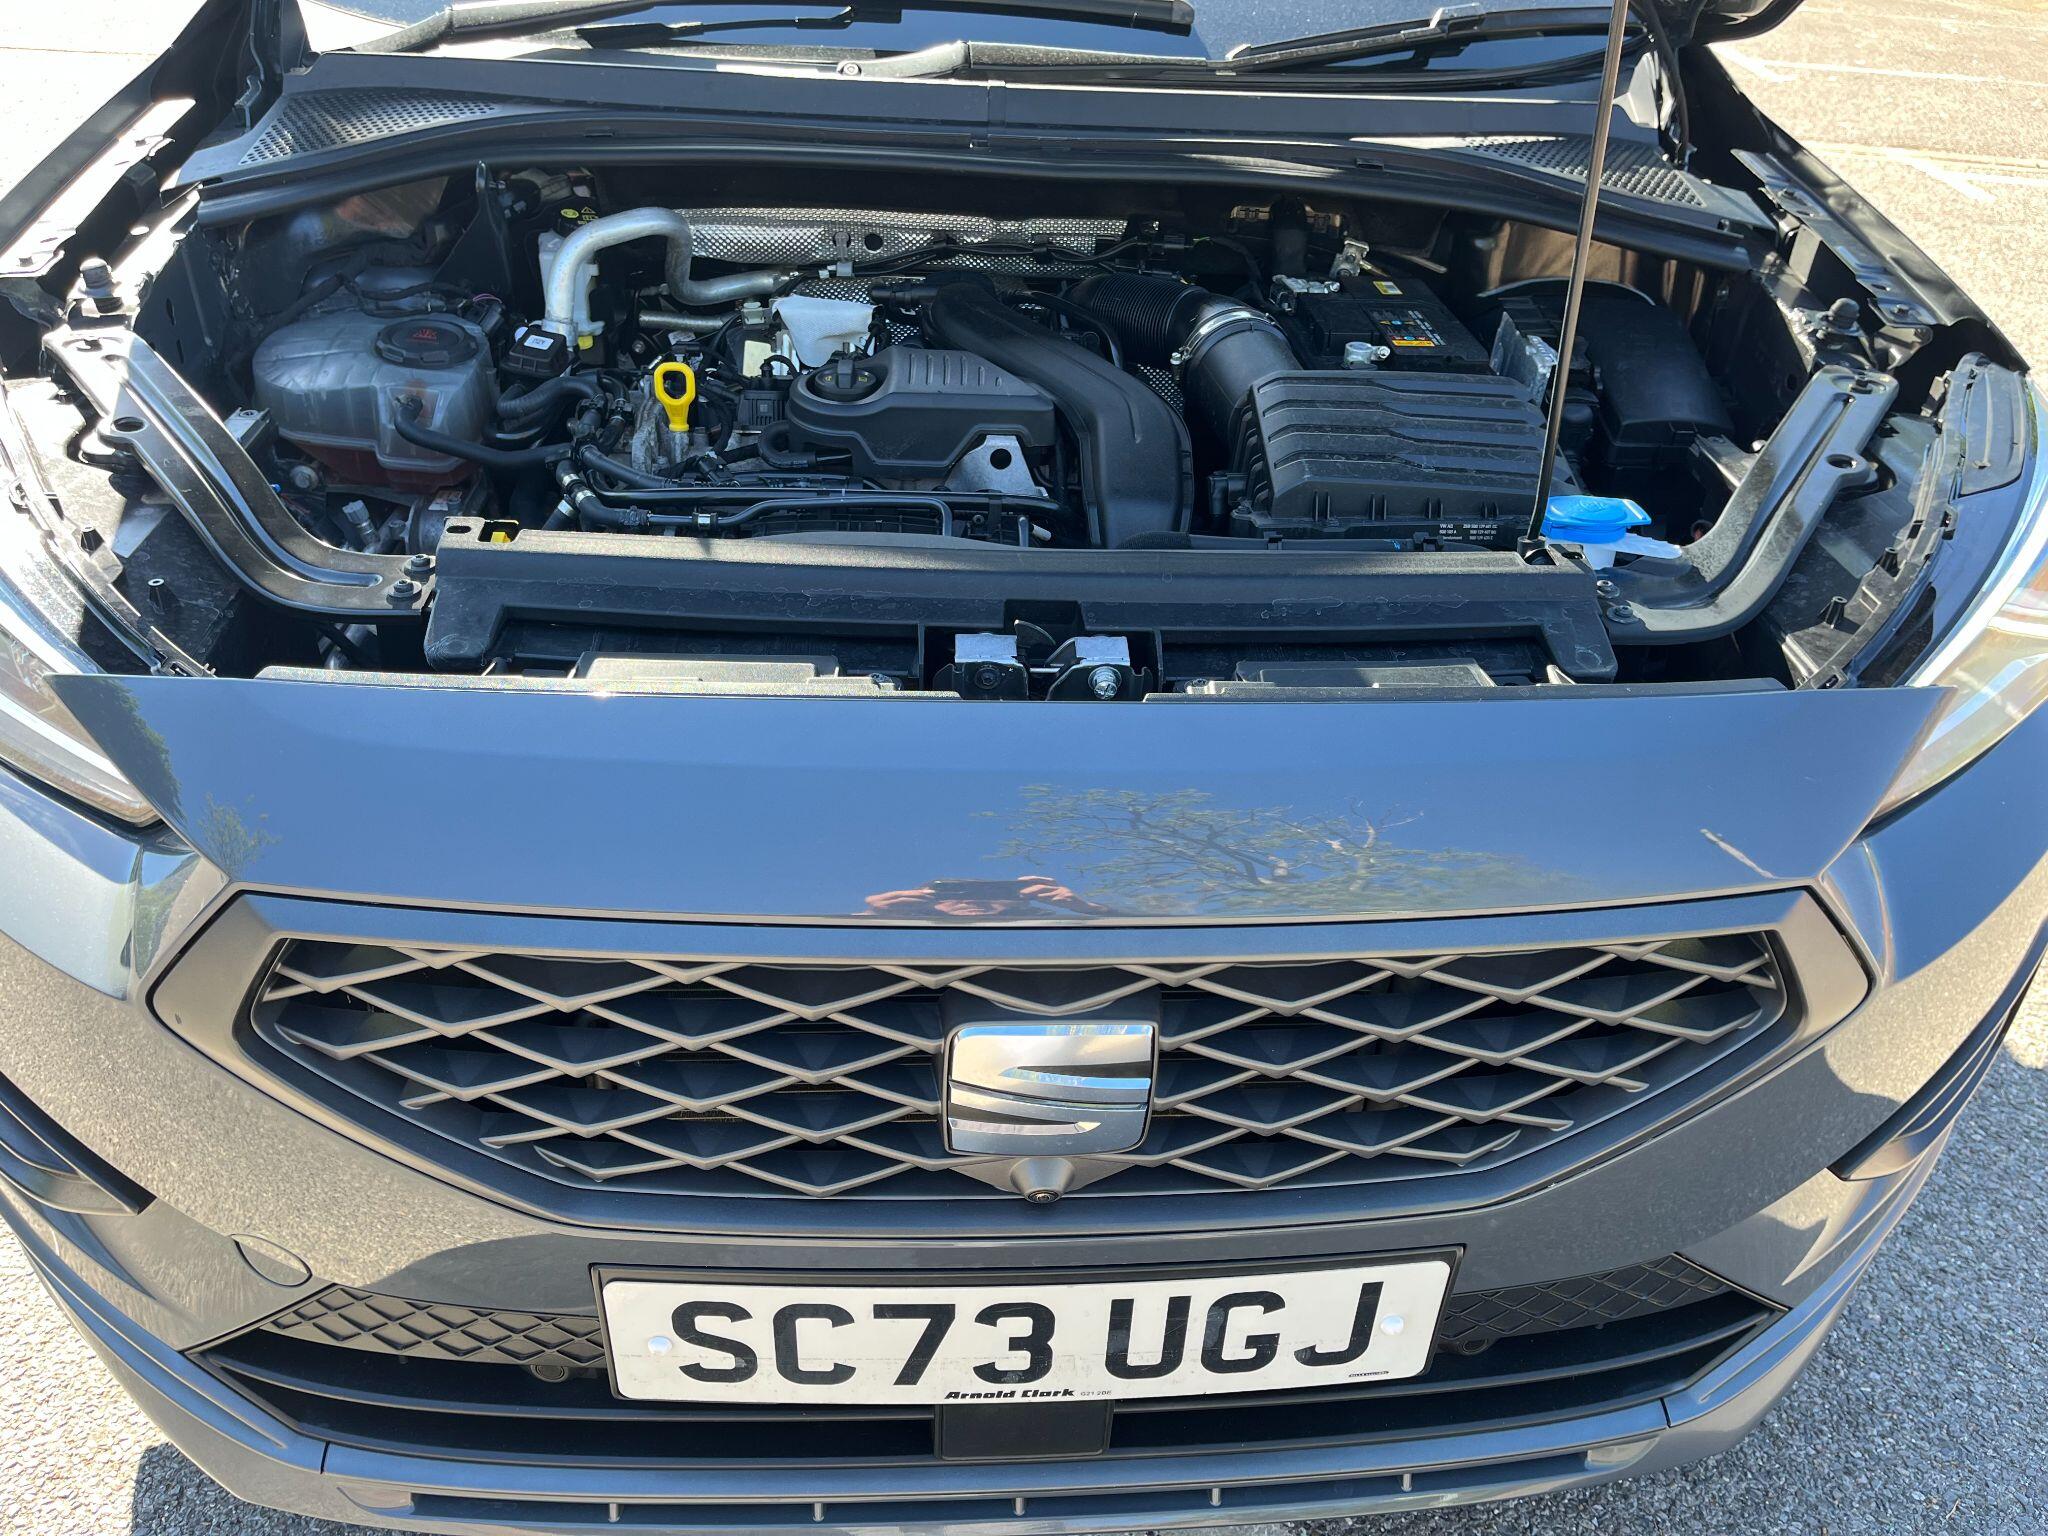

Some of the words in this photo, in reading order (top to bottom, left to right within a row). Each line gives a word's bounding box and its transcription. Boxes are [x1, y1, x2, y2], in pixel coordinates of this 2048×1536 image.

[671, 1300, 1056, 1386] SC73
[1104, 1281, 1384, 1380] UGJ
[944, 1390, 1015, 1400] Arnold
[1021, 1388, 1075, 1398] Clark
